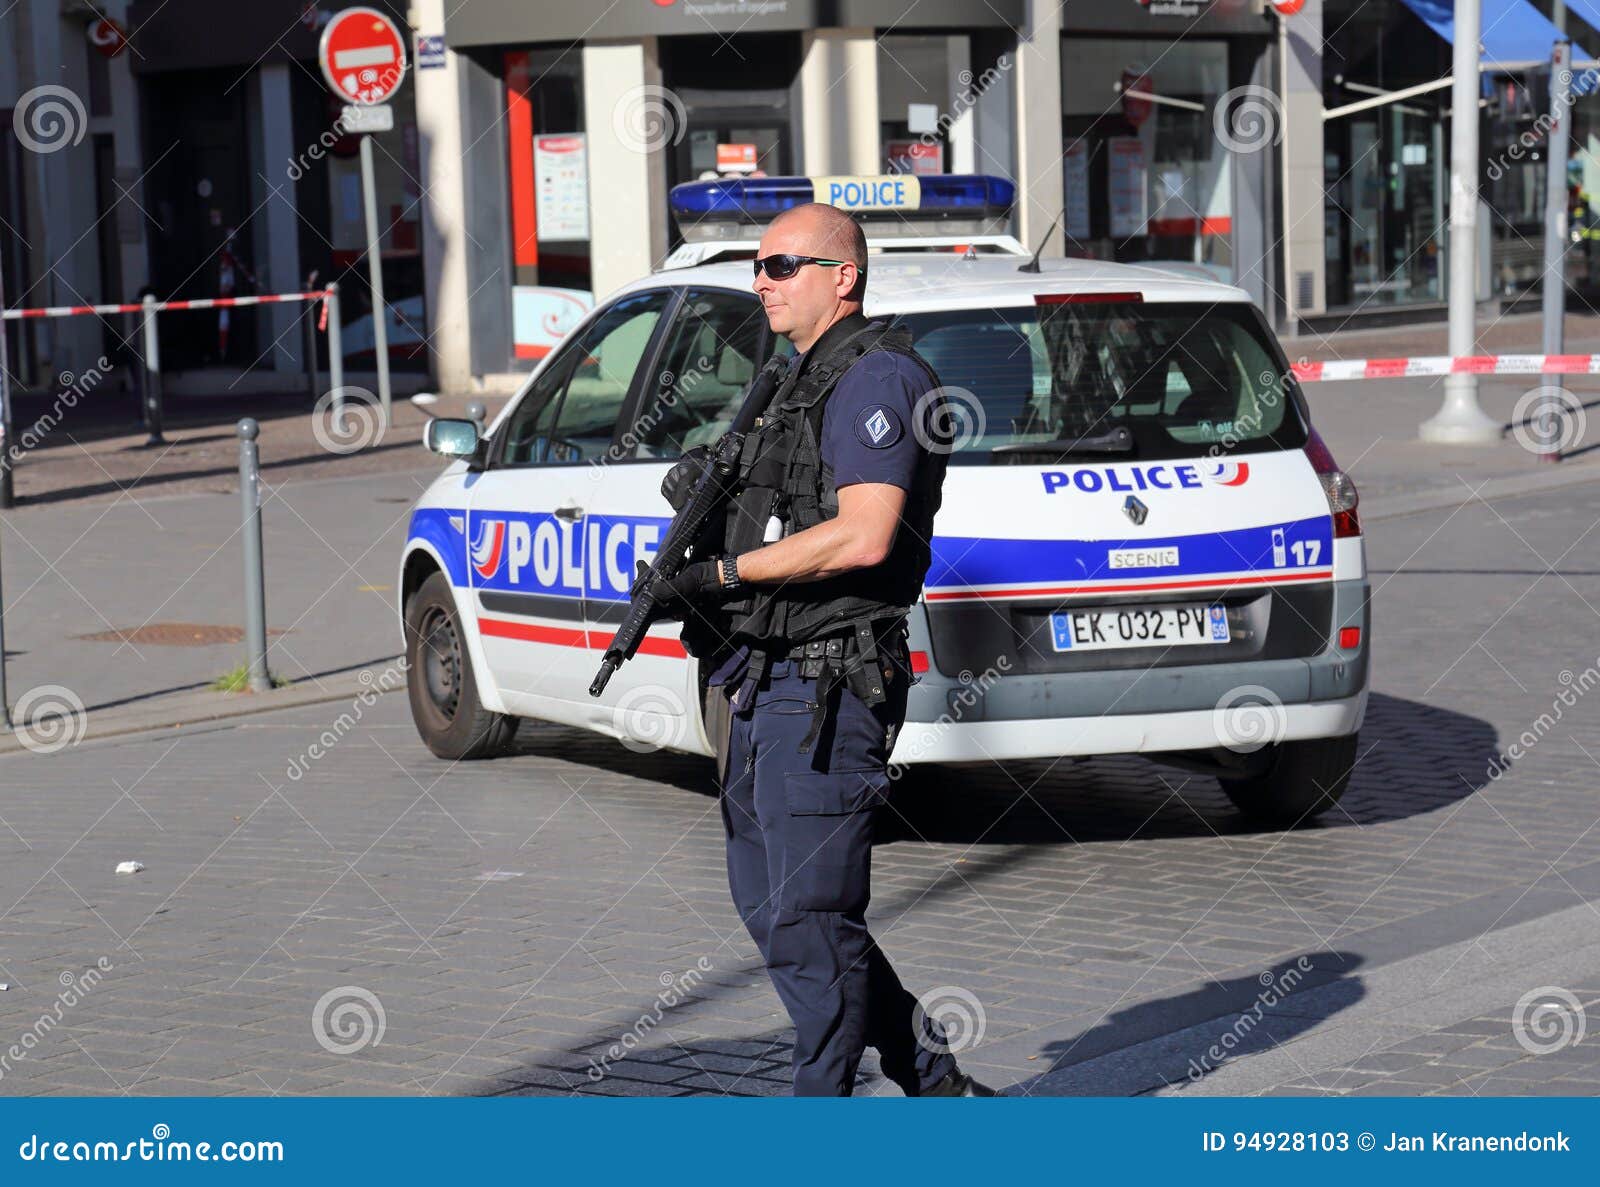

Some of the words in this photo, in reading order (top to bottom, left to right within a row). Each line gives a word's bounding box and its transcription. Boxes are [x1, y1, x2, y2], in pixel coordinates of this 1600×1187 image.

[829, 182, 905, 207] POLICE
[1041, 465, 1203, 494] POLICE
[1114, 551, 1176, 568] SCENIC
[1290, 540, 1321, 566] 17
[1072, 607, 1206, 643] EK-032-PV
[1212, 622, 1226, 637] 59
